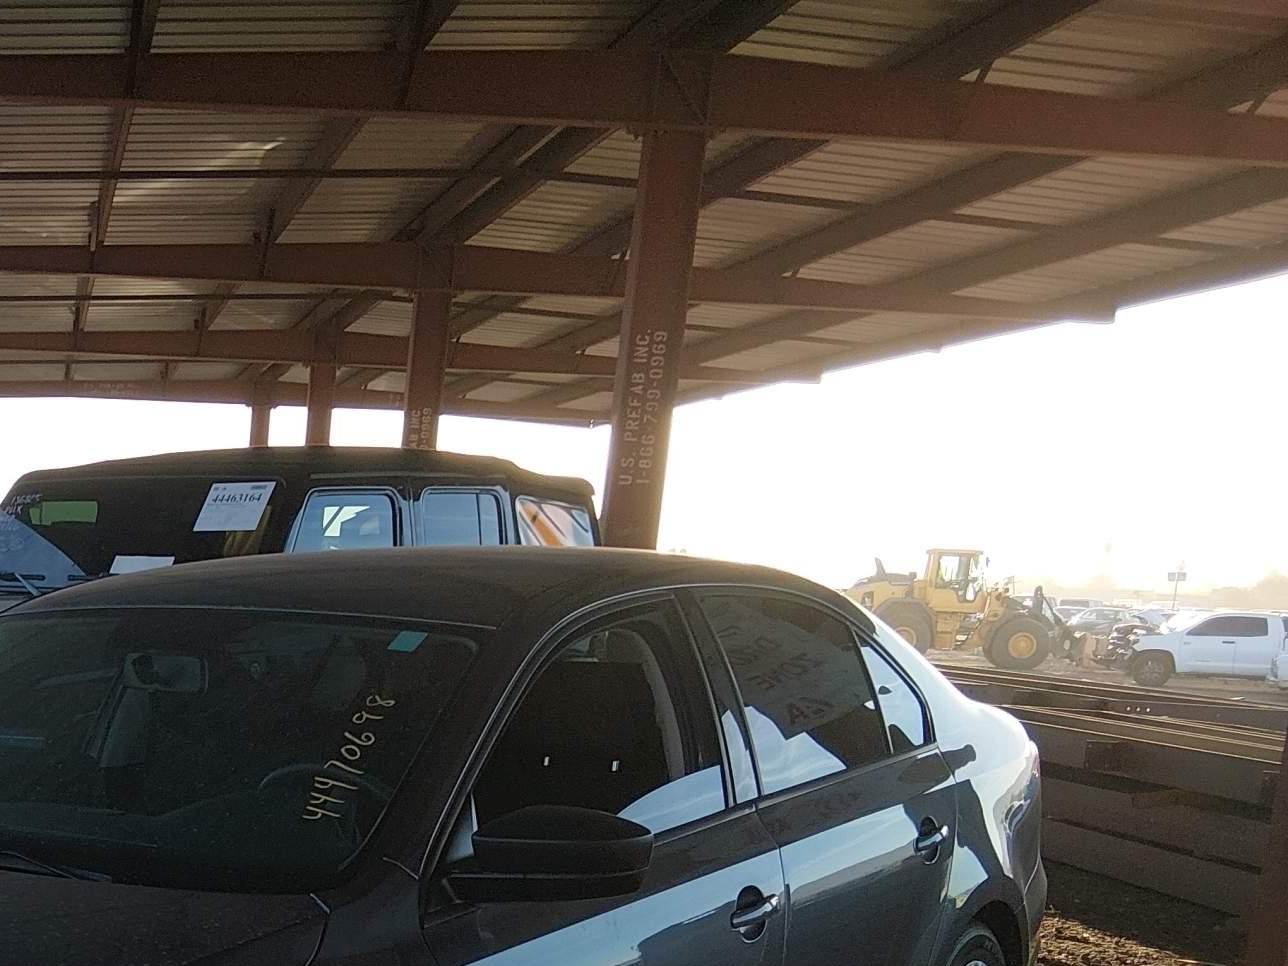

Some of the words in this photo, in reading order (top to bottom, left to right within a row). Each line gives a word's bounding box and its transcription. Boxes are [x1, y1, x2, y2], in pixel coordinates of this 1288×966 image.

[633, 329, 652, 364] INC.
[623, 372, 645, 442] PREFAB
[618, 450, 637, 486] U.S.
[211, 493, 263, 504] 44463164
[302, 694, 397, 820] 44470698
